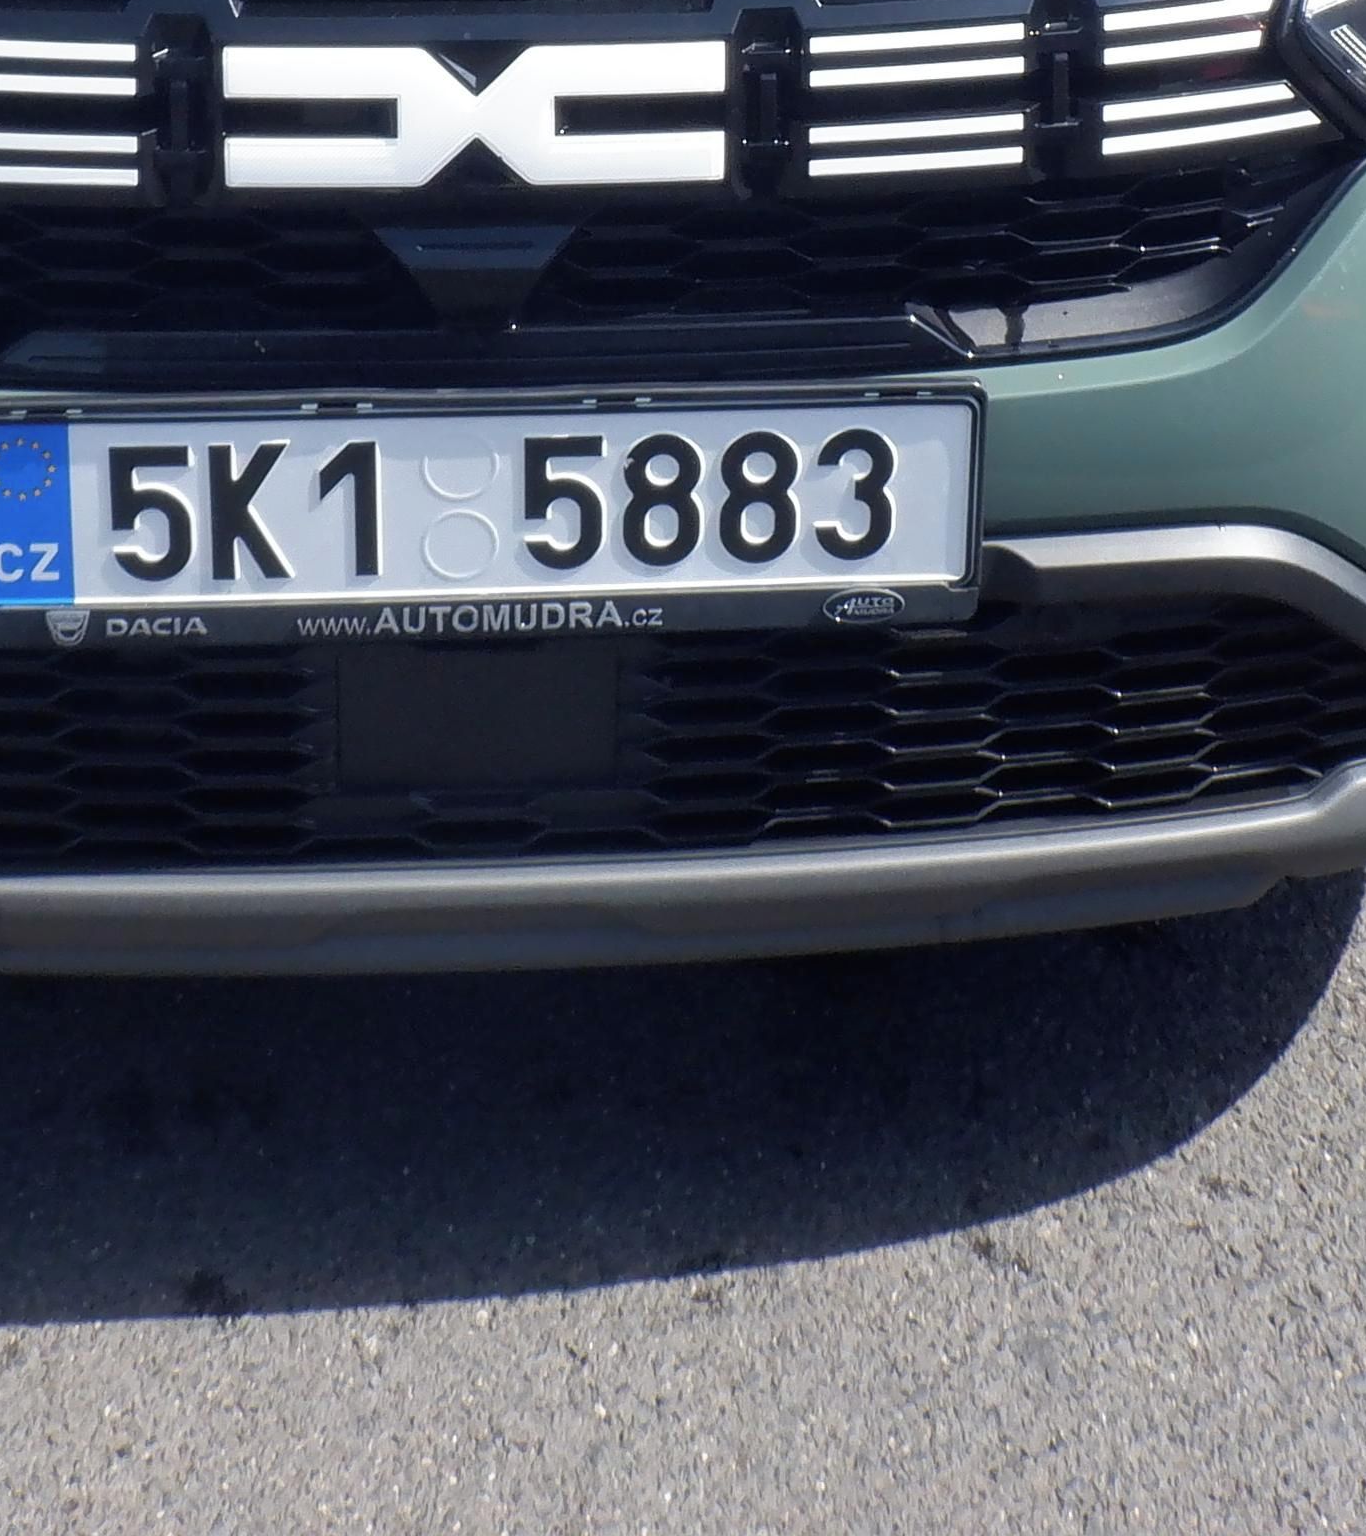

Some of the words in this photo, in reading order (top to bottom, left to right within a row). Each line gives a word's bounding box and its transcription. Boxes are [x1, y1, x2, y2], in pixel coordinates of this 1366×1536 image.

[108, 439, 381, 581] 5K1
[524, 428, 896, 570] 5883
[106, 617, 208, 637] DACIA
[296, 600, 664, 636] www.AUTOMUDRA.cz
